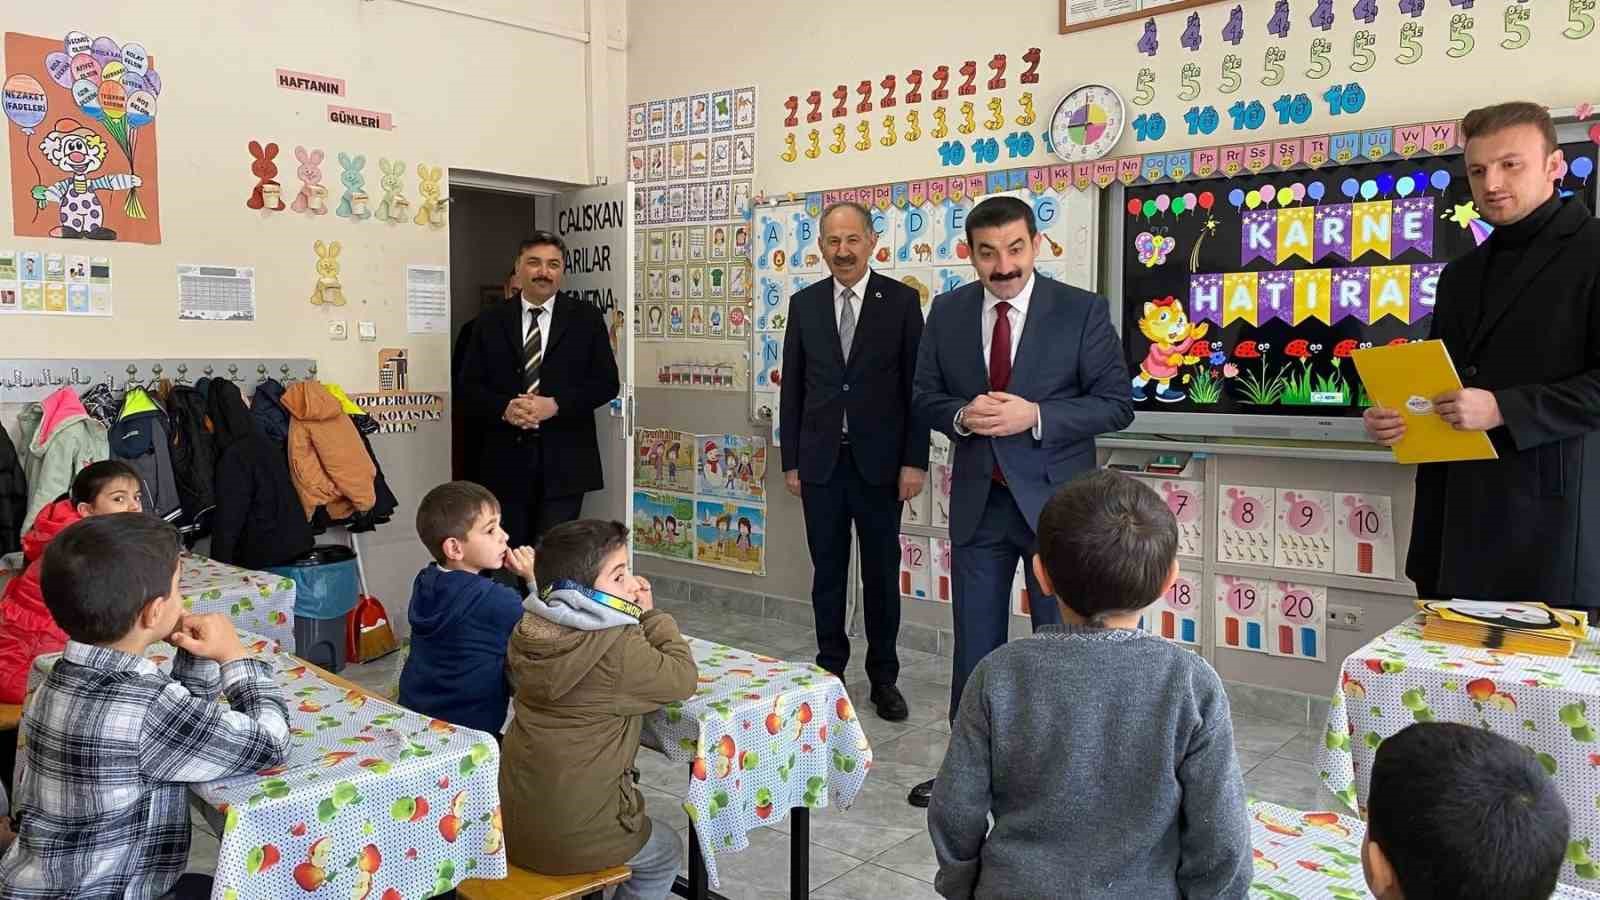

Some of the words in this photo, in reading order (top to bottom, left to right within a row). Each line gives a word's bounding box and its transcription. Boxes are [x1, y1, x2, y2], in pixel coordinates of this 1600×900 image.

[4, 90, 44, 101] NEZAKET
[279, 74, 339, 95] HAFTANIN
[330, 110, 381, 129] GÜNLERİ
[1132, 112, 1167, 142] 10
[1184, 105, 1220, 135] 10
[1228, 99, 1266, 130] 10
[1273, 93, 1313, 124] 10
[1323, 82, 1366, 115] 10
[1055, 169, 1069, 179] Kk
[1097, 163, 1115, 173] Mm
[1122, 160, 1138, 170] Nn
[1200, 153, 1214, 164] Pp
[1226, 151, 1240, 161] Rr
[1250, 148, 1266, 158] Ss
[1311, 141, 1324, 152] Tt
[1401, 131, 1419, 141] Vv
[1431, 125, 1450, 140] Yy
[768, 225, 779, 242] A
[802, 223, 811, 241] B
[910, 212, 923, 232] D
[952, 208, 963, 229] E
[1037, 201, 1055, 222] G
[1249, 210, 1424, 250] KARNE
[564, 245, 611, 274] ARILAR
[767, 343, 778, 361] N
[1175, 495, 1188, 516] 7
[1241, 502, 1254, 524] 8
[1300, 506, 1313, 528] 9
[1354, 510, 1380, 534] 10
[906, 547, 923, 567] 12
[1170, 583, 1191, 605] 18
[1233, 588, 1256, 610] 19
[1284, 594, 1314, 619] 20
